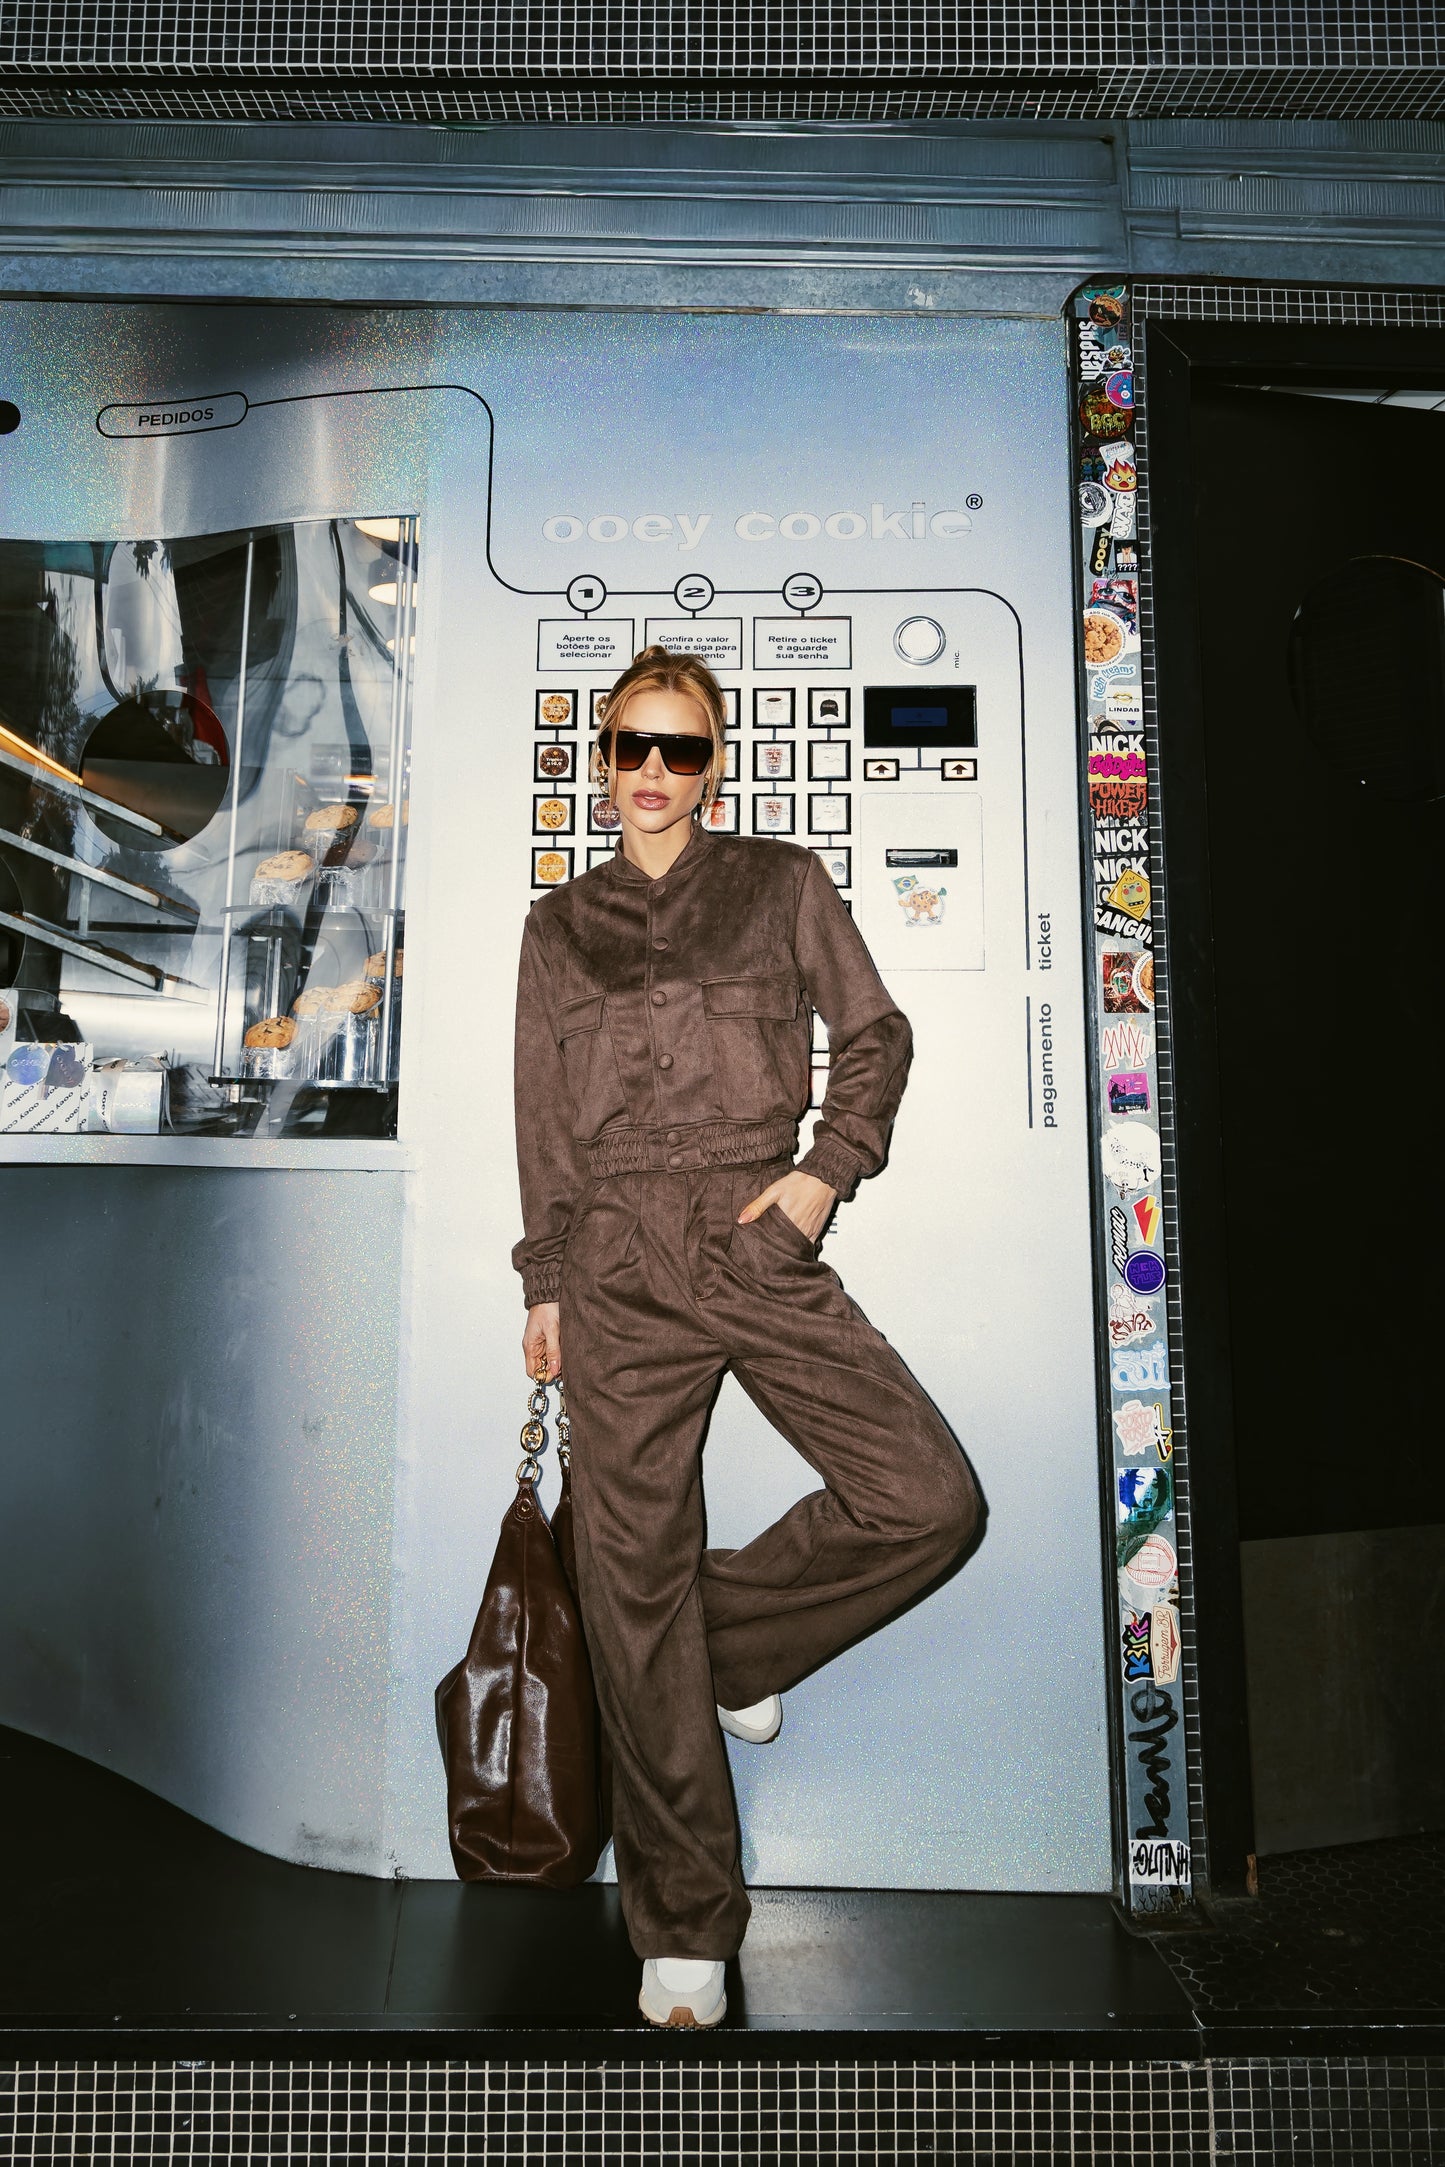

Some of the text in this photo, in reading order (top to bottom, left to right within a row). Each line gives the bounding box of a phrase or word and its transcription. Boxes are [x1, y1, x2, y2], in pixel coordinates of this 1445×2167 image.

[138, 407, 215, 427] PEDIDOS
[542, 513, 714, 551] ooey
[734, 502, 973, 543] cookie
[577, 588, 594, 599] 1
[683, 587, 706, 598] 2
[789, 586, 816, 597] 3
[562, 634, 596, 643] Aperte
[659, 635, 694, 643] Confira
[768, 635, 797, 643] Retire
[810, 636, 837, 644] ticket
[556, 643, 590, 651] botões
[693, 644, 713, 652] siga
[786, 644, 828, 653] aguarde
[560, 651, 612, 659] selecionar
[797, 652, 829, 660] senha
[1090, 734, 1145, 752] NICK
[1094, 828, 1150, 853] NICK
[1093, 856, 1150, 882] NICK
[1037, 912, 1052, 971] ticket
[1038, 1003, 1058, 1128] pagamento
